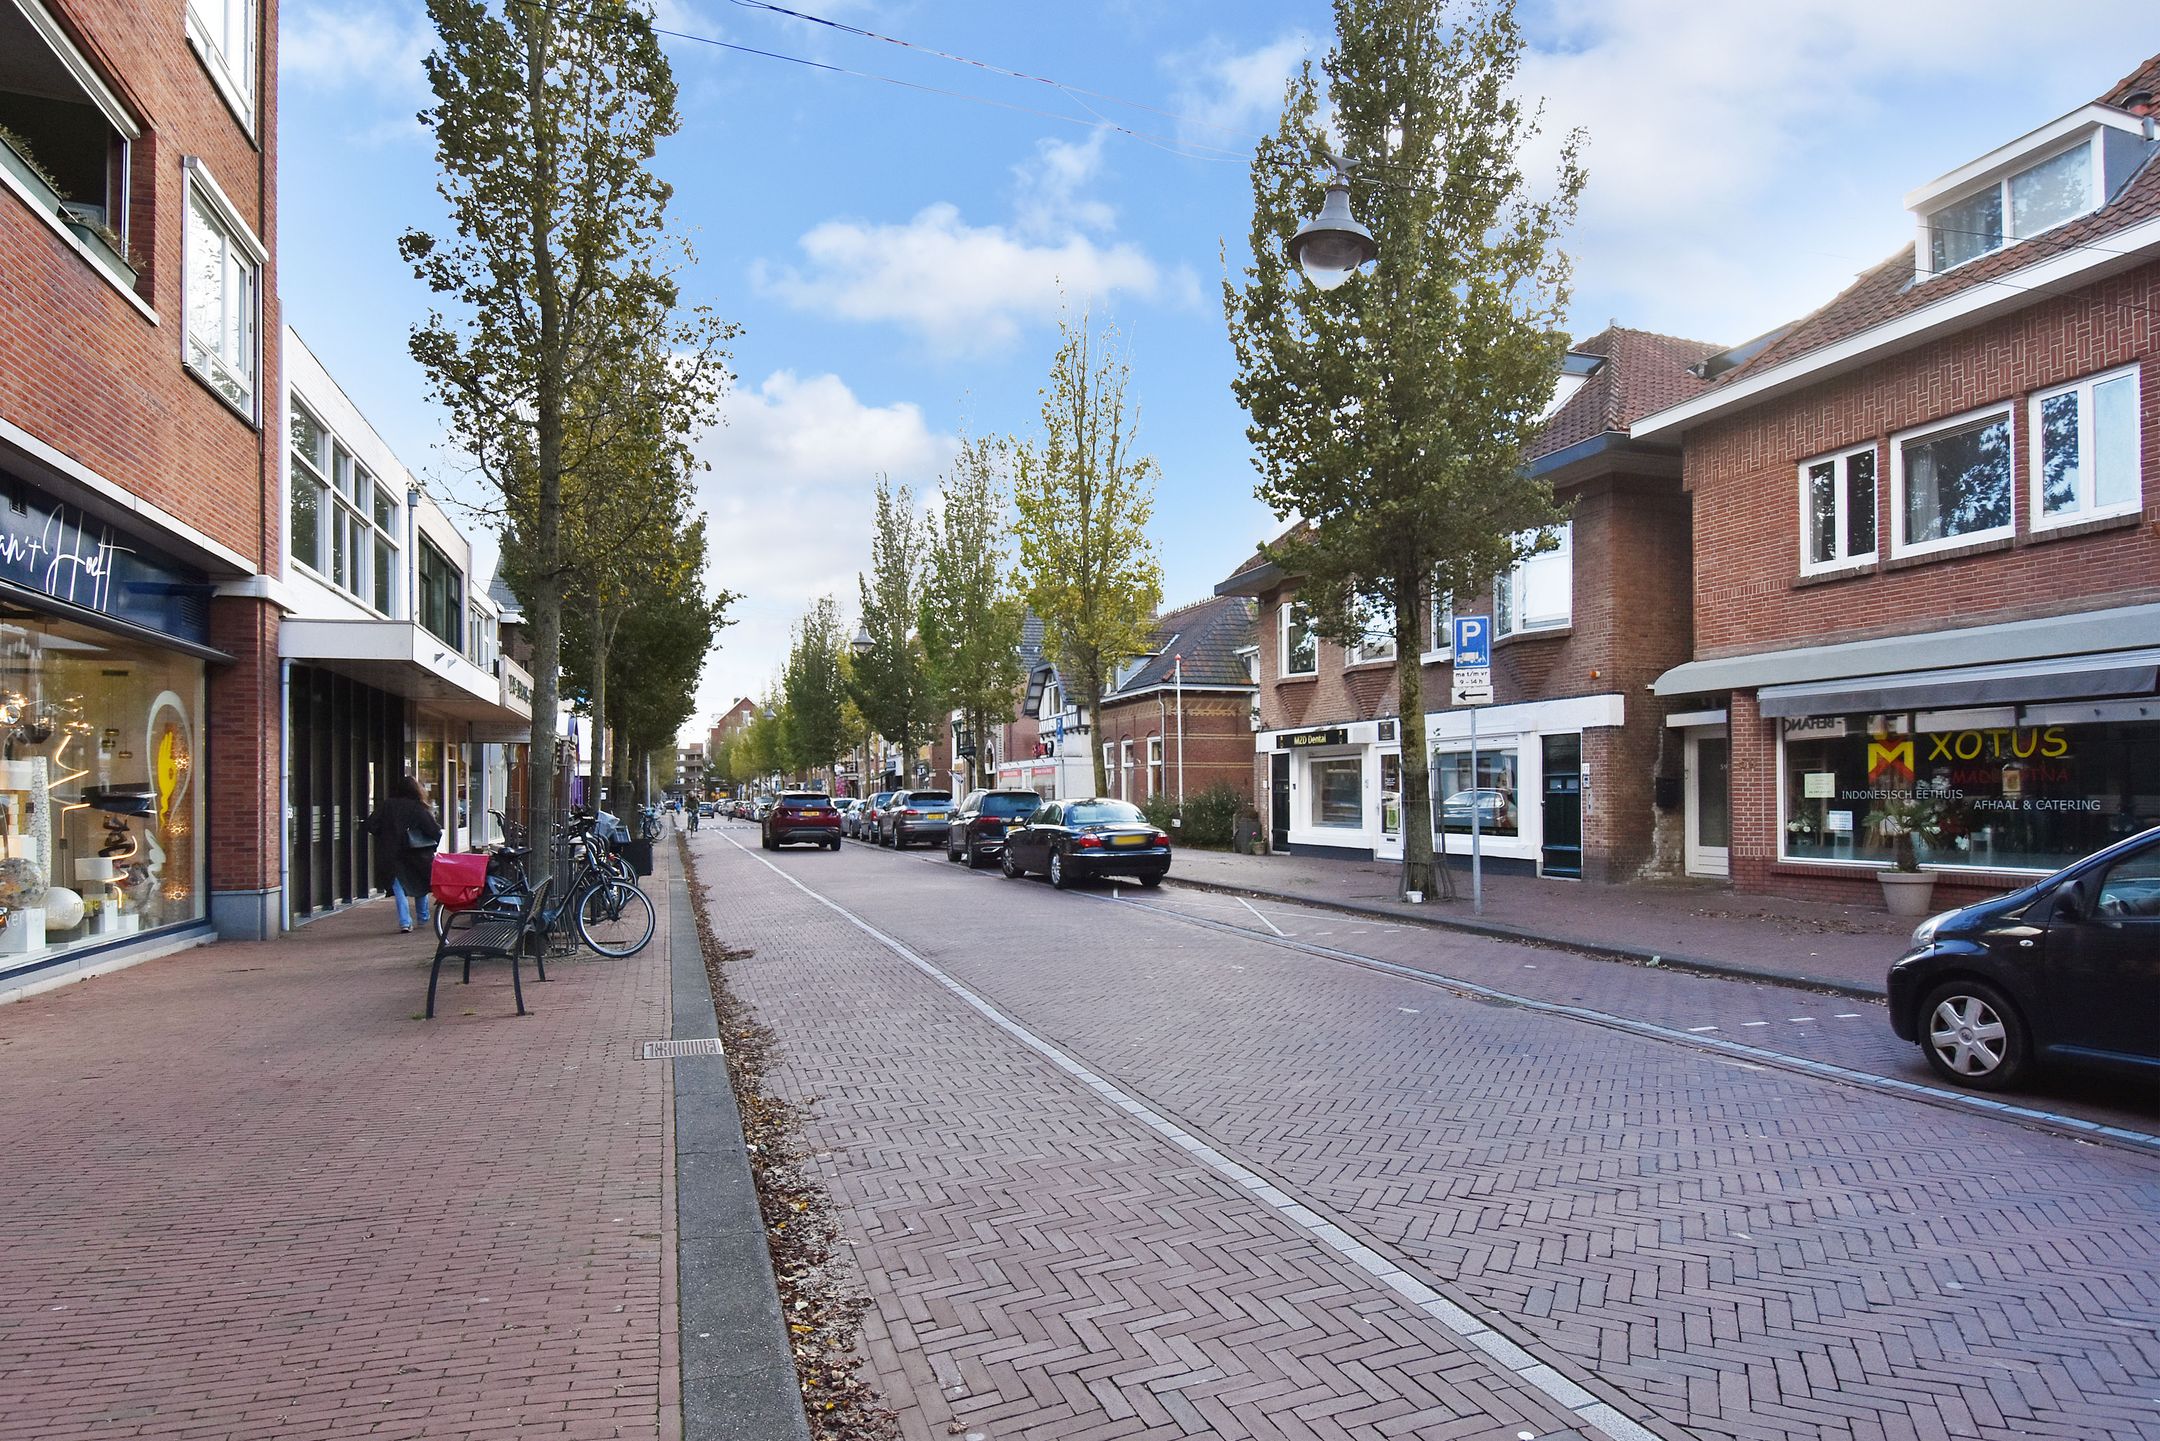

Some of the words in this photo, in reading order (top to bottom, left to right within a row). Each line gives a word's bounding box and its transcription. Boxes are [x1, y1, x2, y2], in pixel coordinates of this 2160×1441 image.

[1461, 620, 1481, 647] P
[1307, 733, 1327, 744] Dental
[1928, 727, 2068, 761] XOTUS
[1841, 789, 1912, 800] INDONESISCH
[1916, 789, 1964, 800] EETHUIS
[1973, 800, 2019, 811] AFHAAL
[2023, 800, 2032, 811] &
[2035, 799, 2101, 811] CATERING
